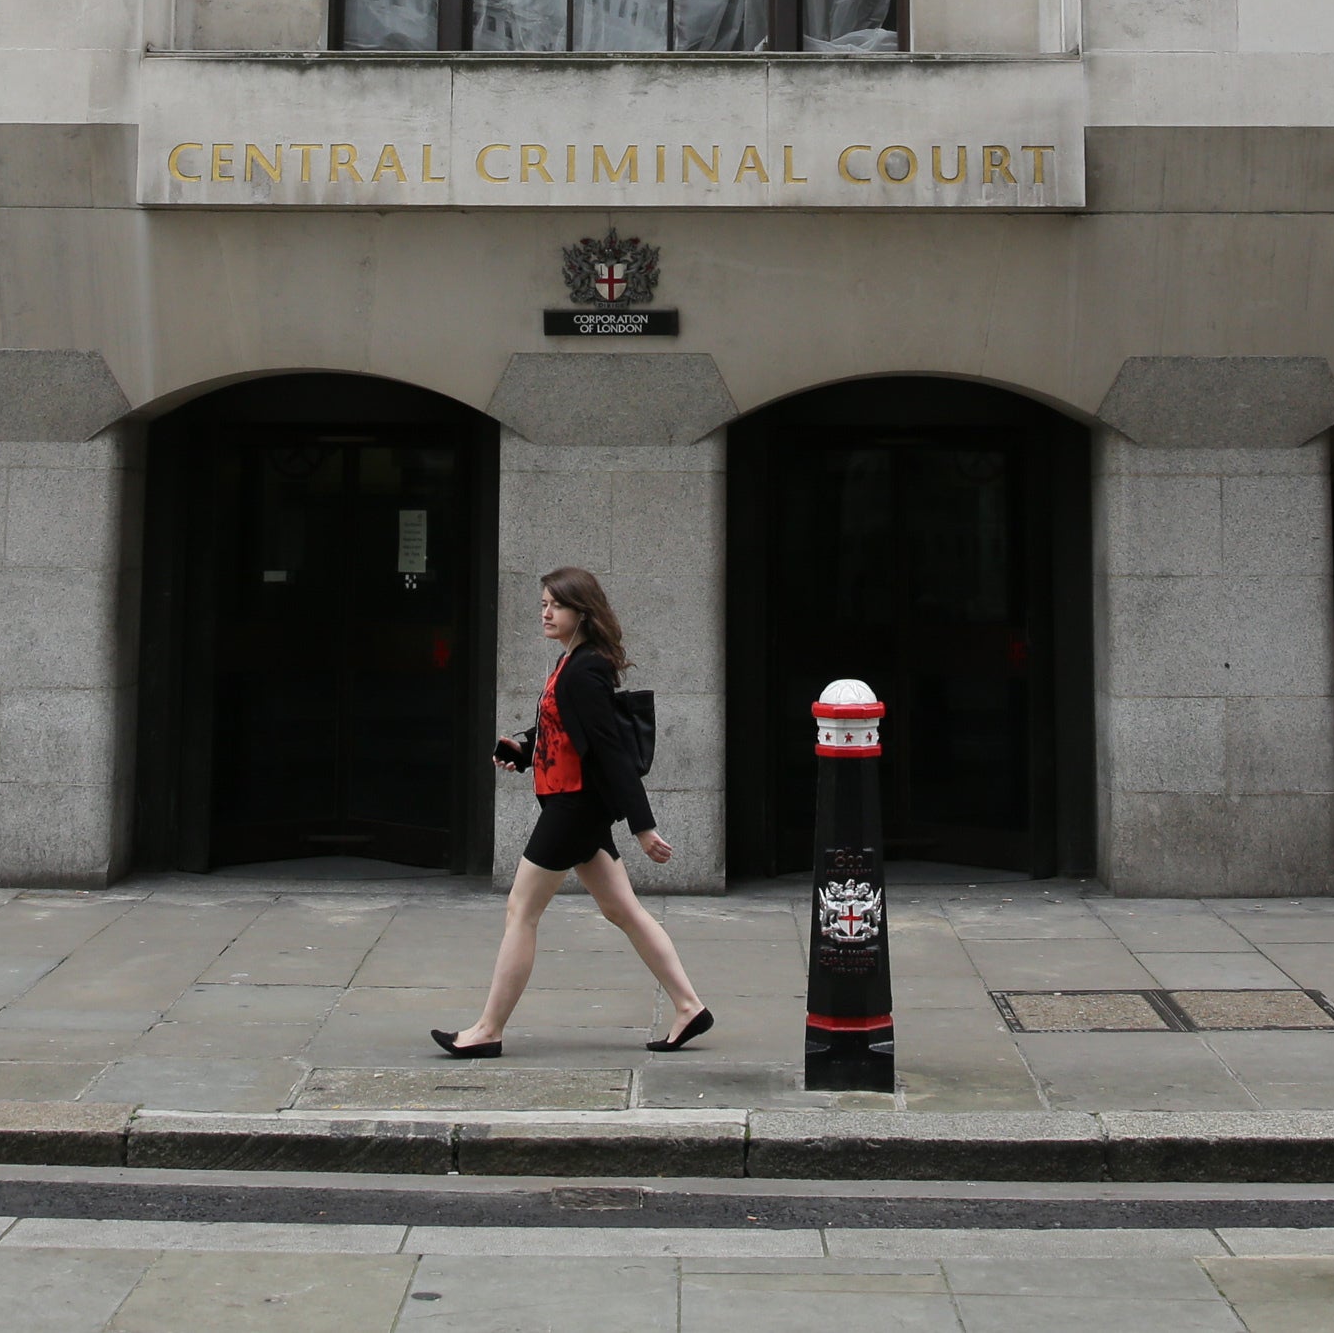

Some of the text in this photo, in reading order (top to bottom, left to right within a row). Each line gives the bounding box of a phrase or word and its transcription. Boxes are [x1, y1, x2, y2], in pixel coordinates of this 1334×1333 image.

[167, 141, 1056, 187] CENTRAL CRIMINAL COURT
[573, 315, 649, 324] CORPORATION
[579, 324, 643, 334] OF LONDON
